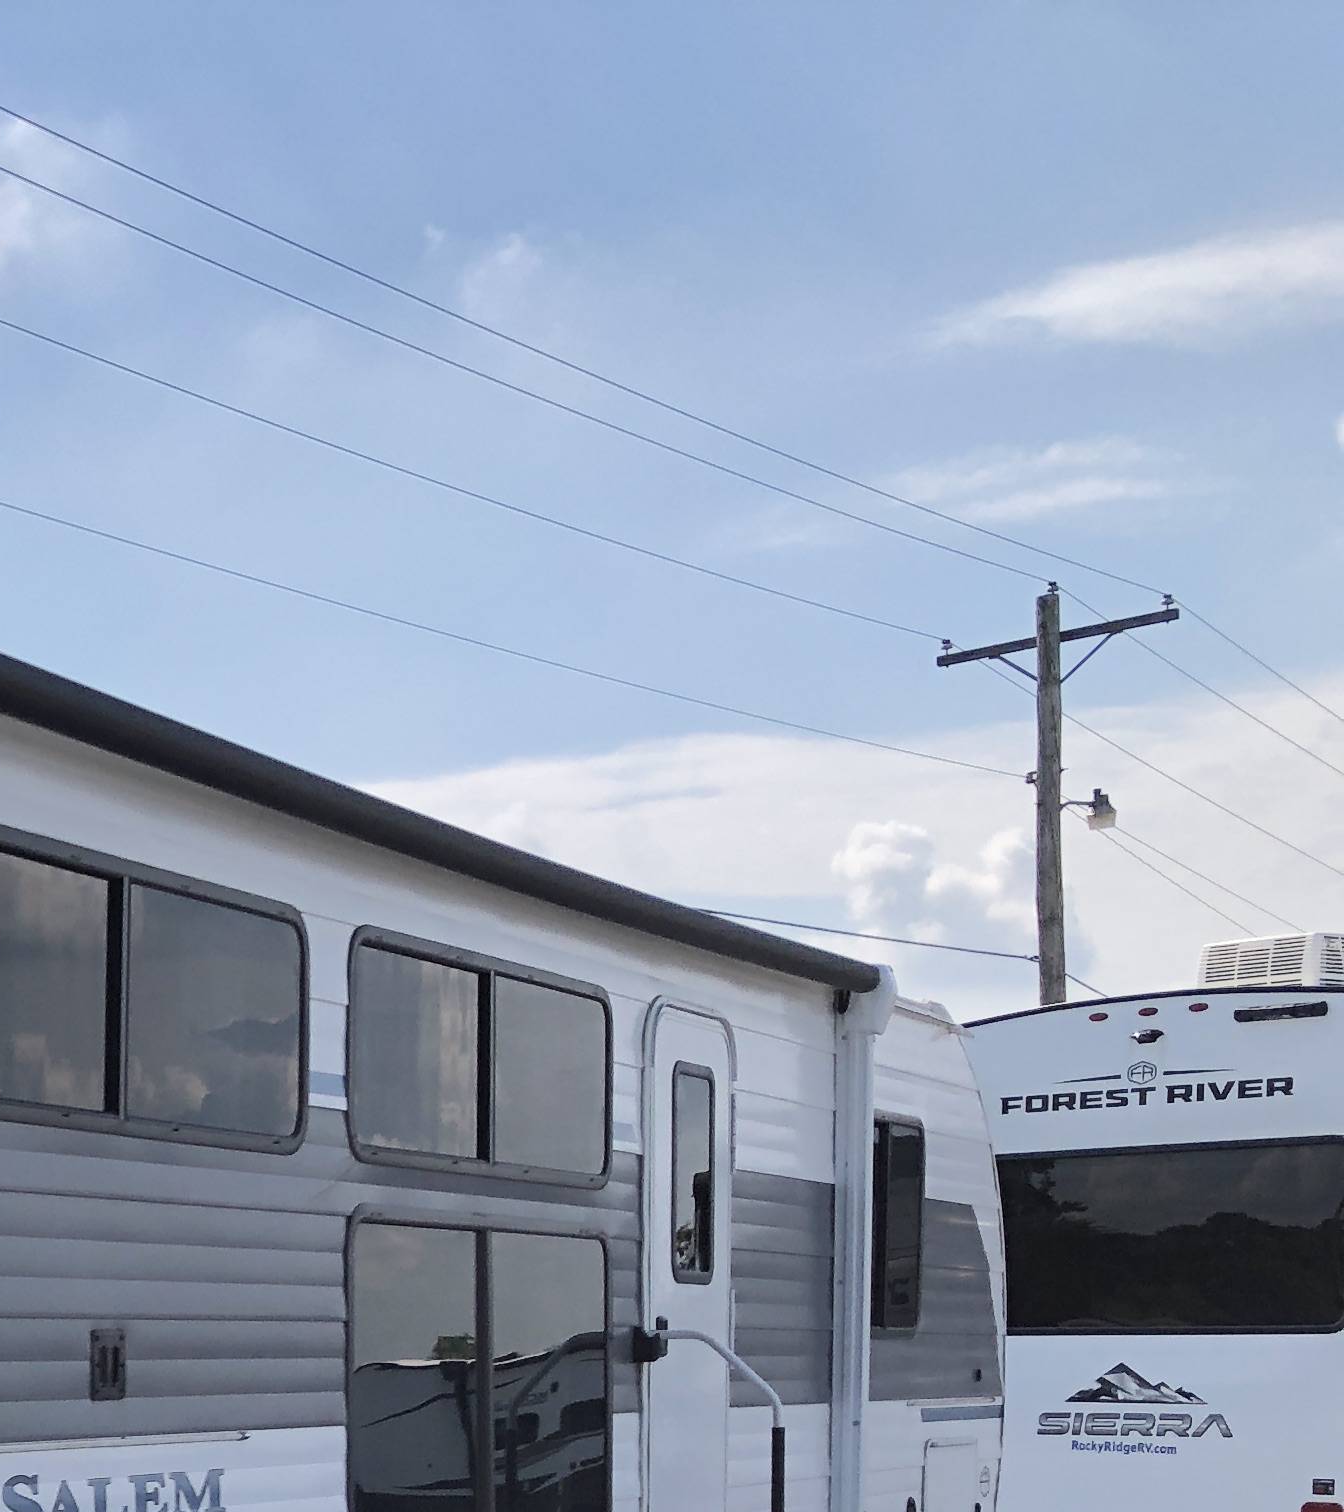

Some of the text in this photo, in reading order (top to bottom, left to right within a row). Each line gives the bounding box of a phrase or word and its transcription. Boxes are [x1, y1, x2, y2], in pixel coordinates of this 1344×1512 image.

[1000, 1077, 1294, 1116] FOREST RIVER
[1036, 1412, 1234, 1438] SIERRA
[1071, 1440, 1178, 1455] RockyRidgeRV.com
